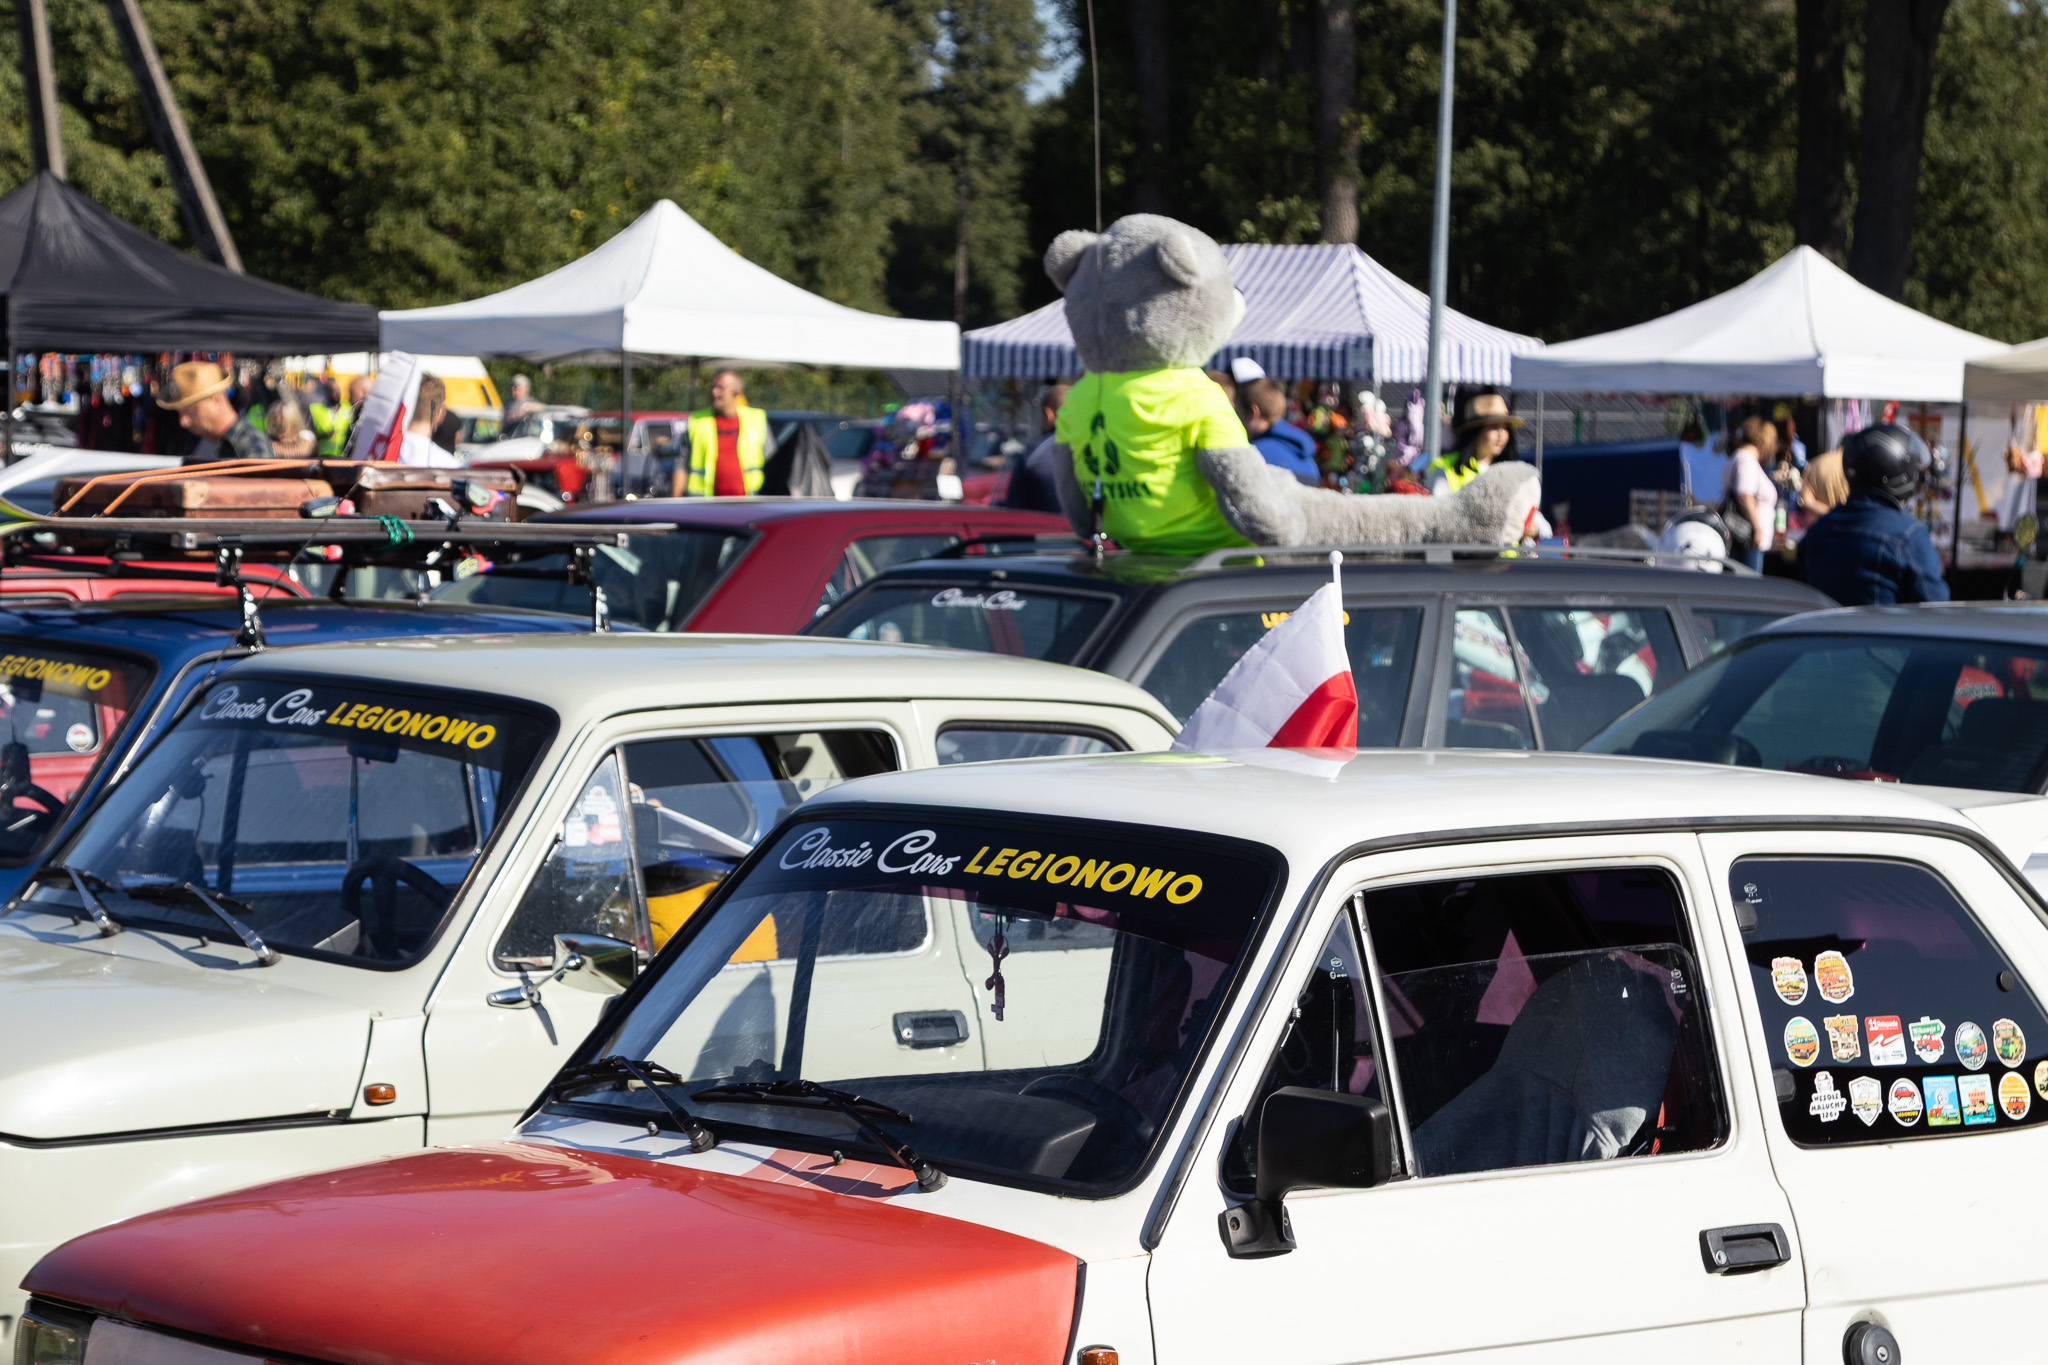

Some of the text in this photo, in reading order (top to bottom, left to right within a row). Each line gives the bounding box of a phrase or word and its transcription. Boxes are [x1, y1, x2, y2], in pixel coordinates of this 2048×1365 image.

[986, 590, 1028, 611] Cars
[200, 685, 497, 750] Classic Cars LEGIONOWO
[779, 826, 1203, 905] Classic Cars LEGIONOWO
[1868, 1018, 1879, 1031] 11
[1811, 1101, 1845, 1111] MALUCHY
